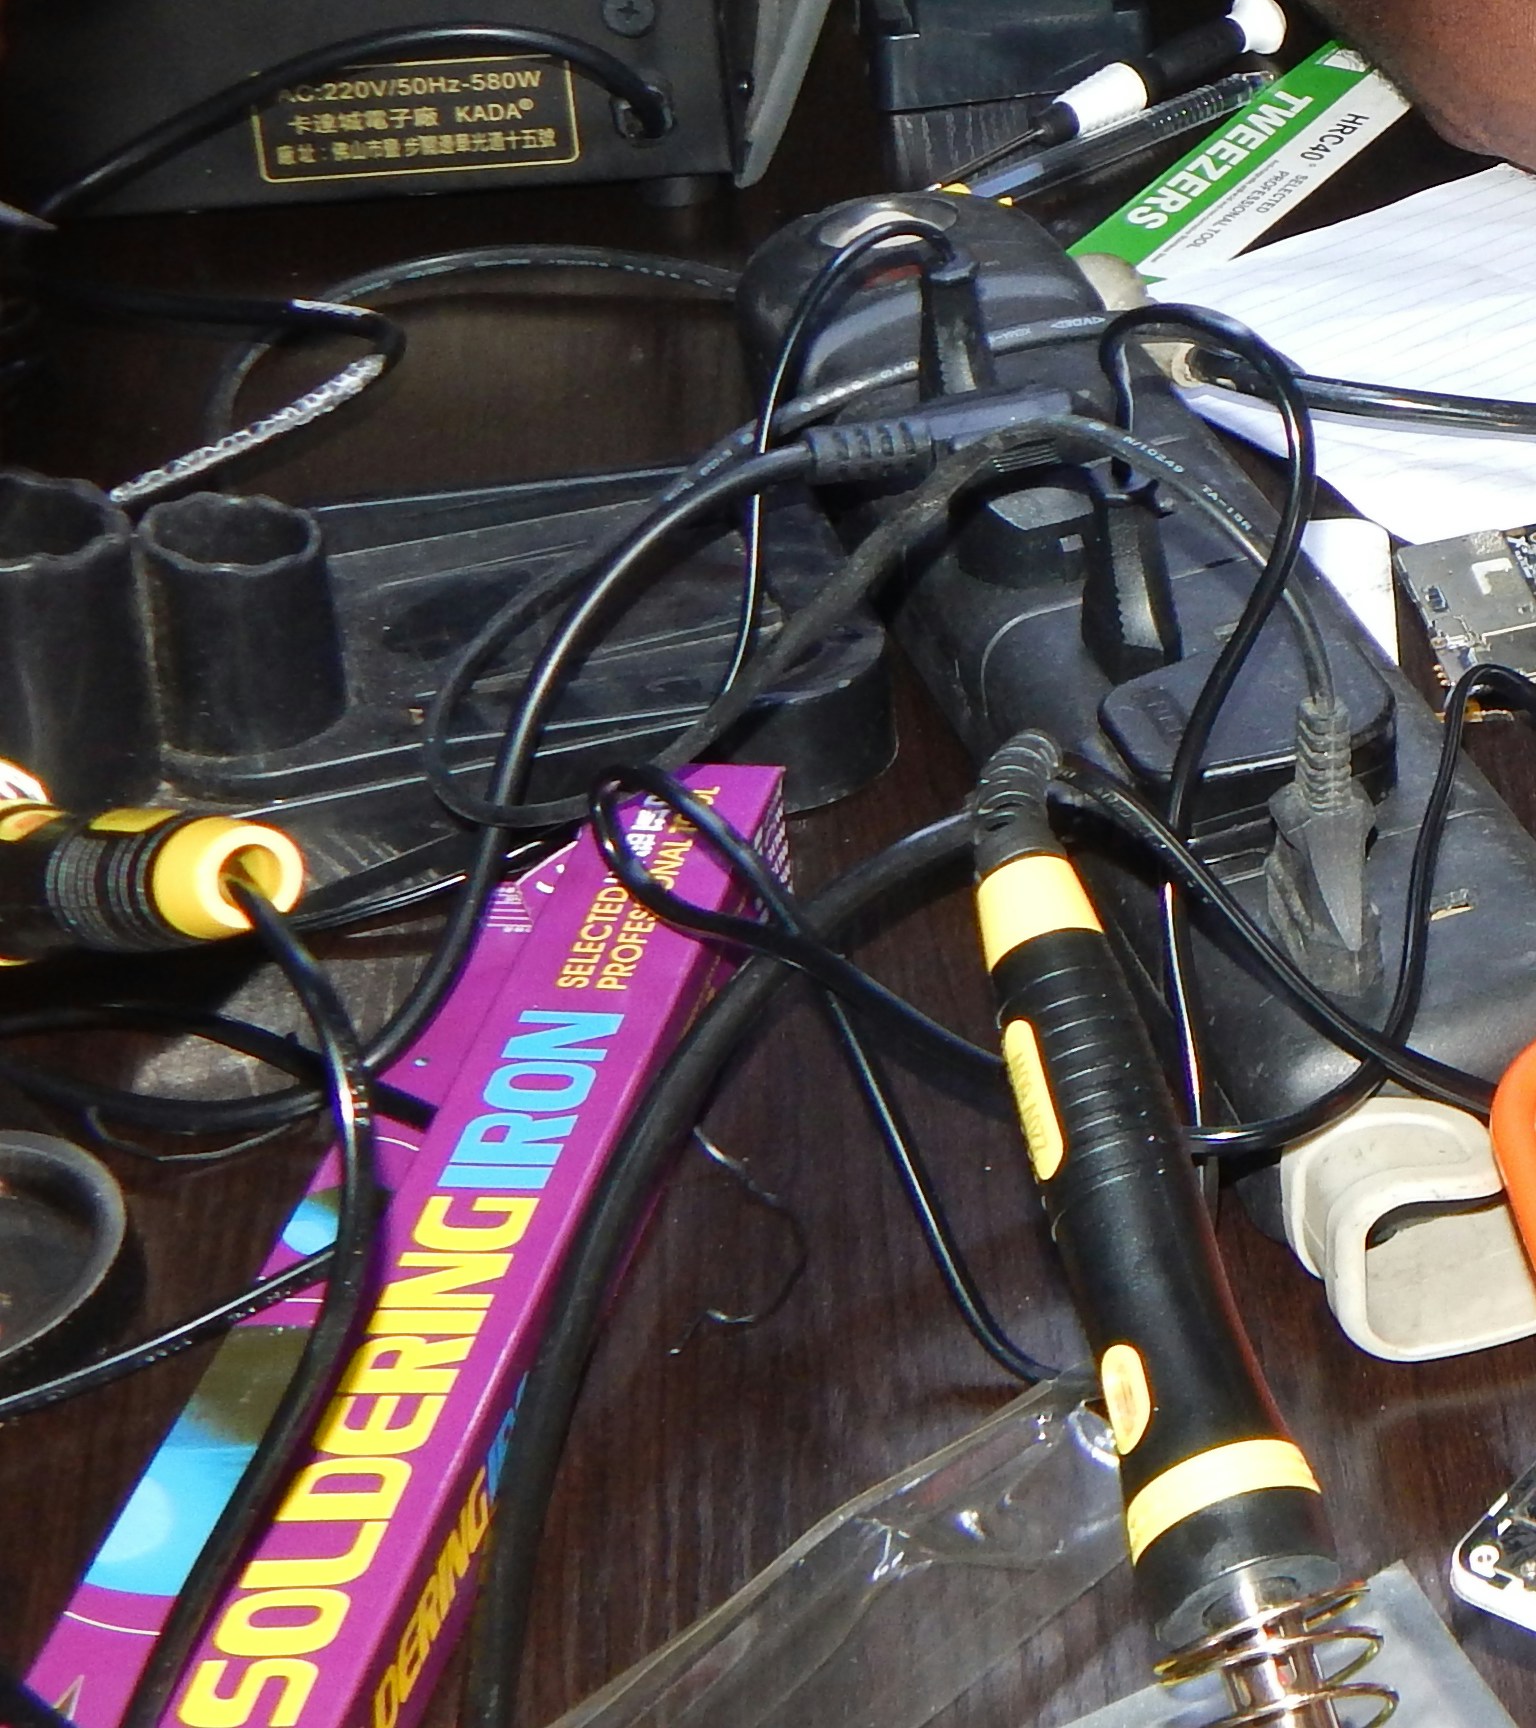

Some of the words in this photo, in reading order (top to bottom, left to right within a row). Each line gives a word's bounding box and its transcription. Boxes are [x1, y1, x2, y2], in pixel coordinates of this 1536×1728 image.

[1127, 90, 1314, 231] TWEEZERS
[1301, 113, 1369, 163] HRC40
[1219, 170, 1290, 235] PROFESSIONAL
[1256, 173, 1309, 214] SELECTED
[1186, 222, 1219, 249] TOOL
[557, 887, 630, 989] SELECTED
[595, 839, 694, 990] PROFESONAL
